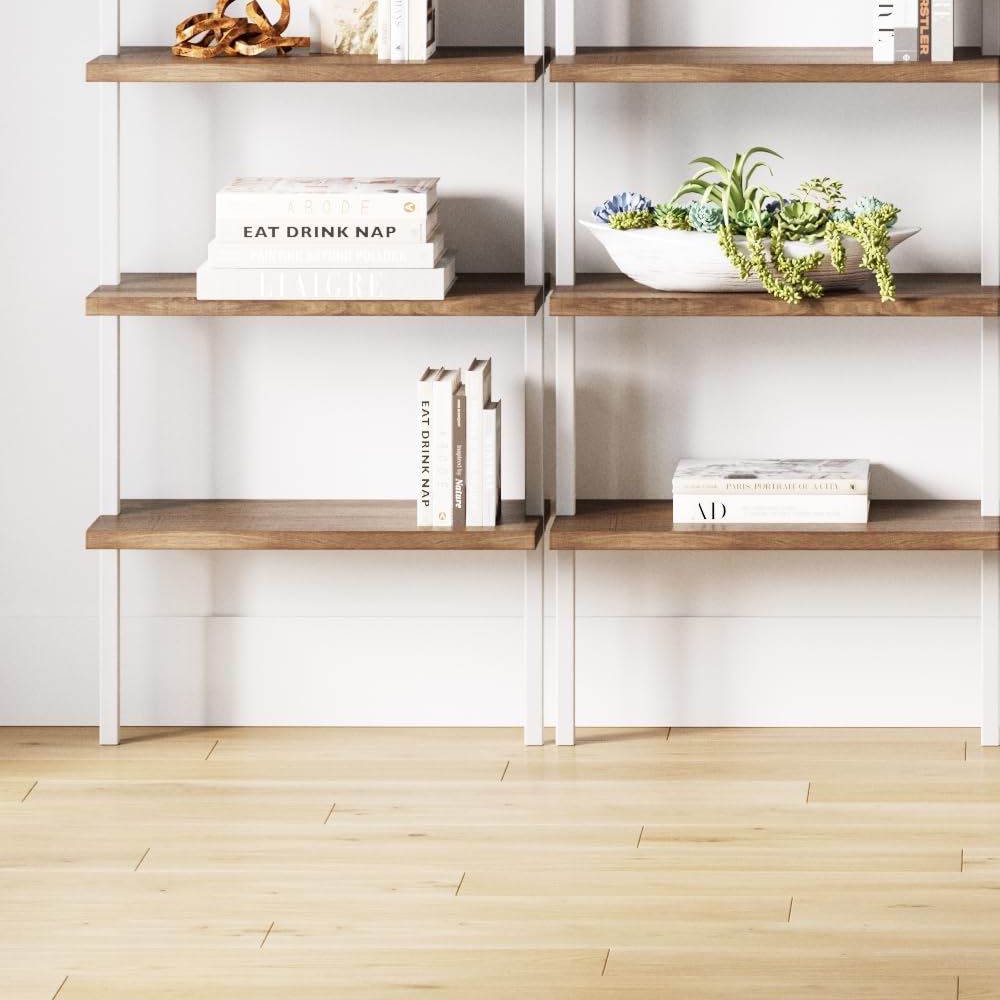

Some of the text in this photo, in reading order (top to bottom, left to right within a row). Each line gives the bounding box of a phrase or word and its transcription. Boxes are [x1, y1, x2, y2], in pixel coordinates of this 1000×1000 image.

[243, 226, 397, 238] EAT DRINK NAP
[421, 400, 430, 507] EAT DRINK NAP
[455, 478, 464, 509] Nature
